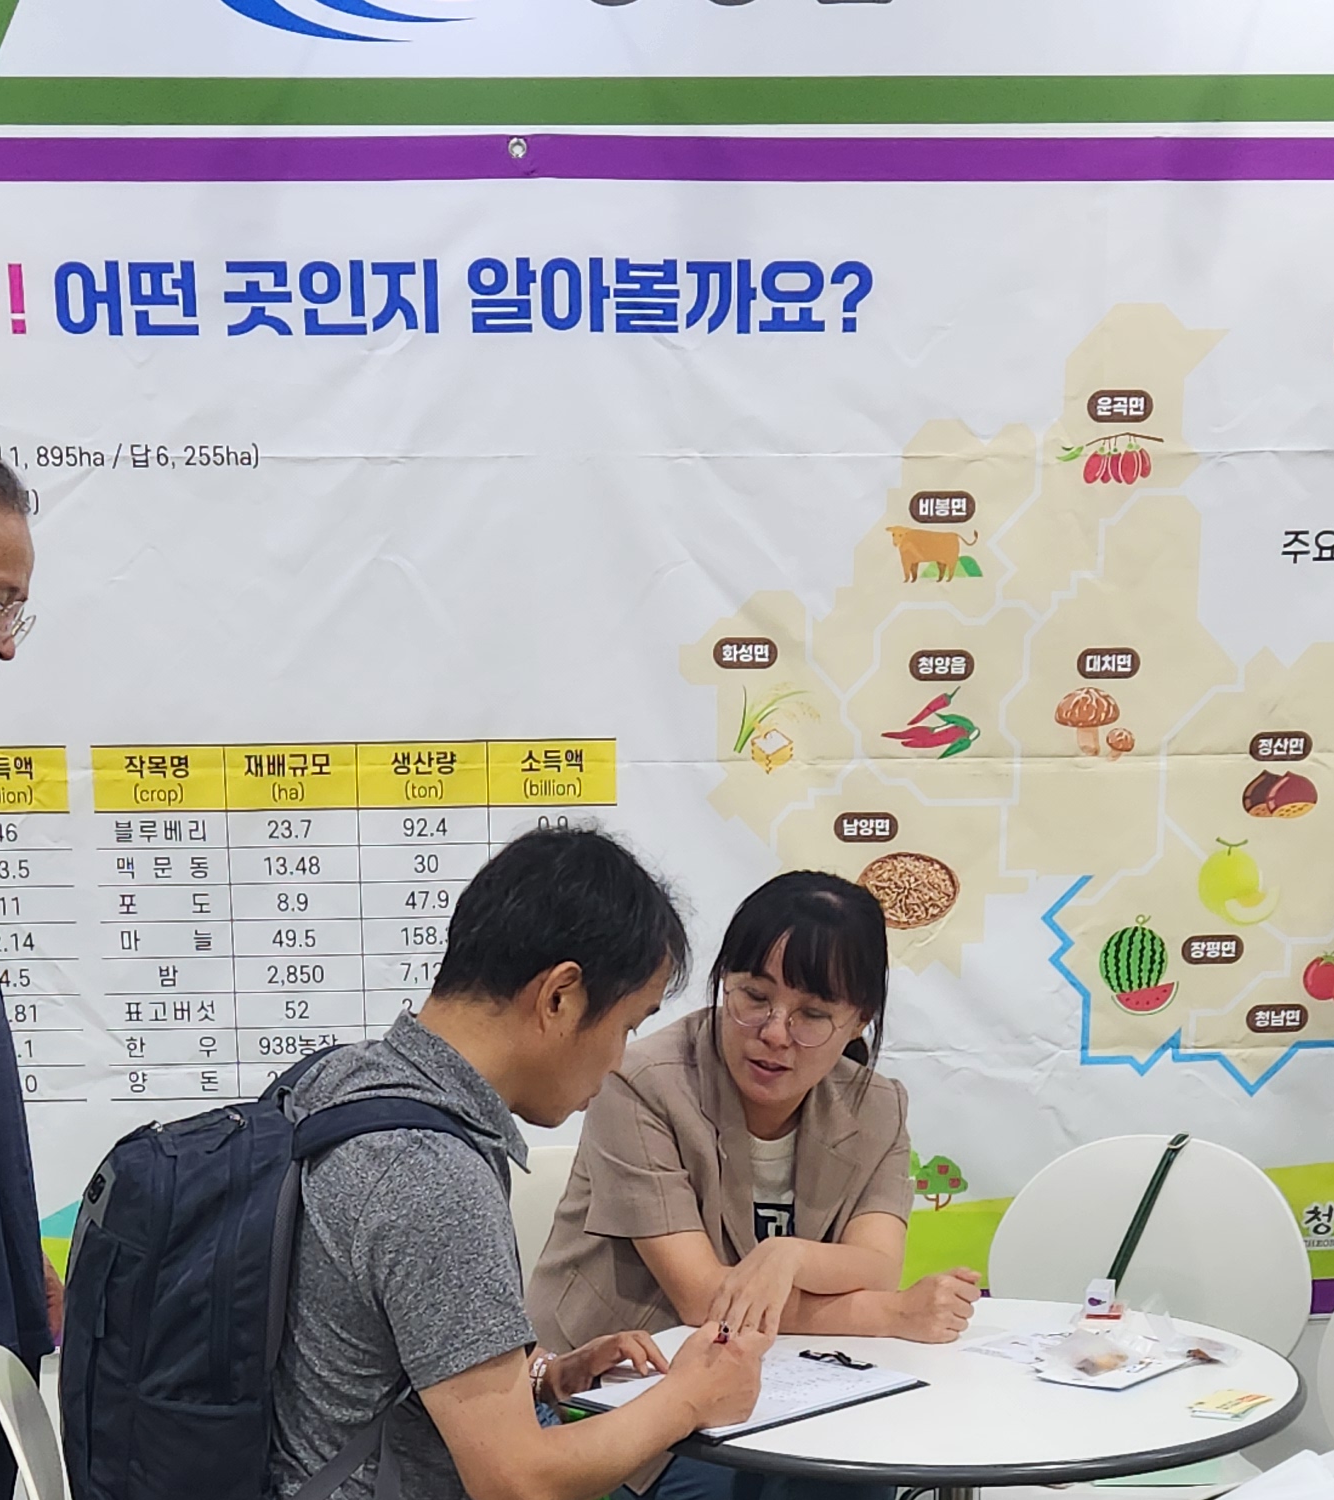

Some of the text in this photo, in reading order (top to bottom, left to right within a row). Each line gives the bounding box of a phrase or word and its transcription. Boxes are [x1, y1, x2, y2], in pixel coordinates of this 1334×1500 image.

[54, 259, 200, 337] 어떤
[223, 258, 440, 337] 곳인지
[468, 256, 874, 335] 알아볼까요?
[1096, 396, 1146, 417] 운곡면
[36, 445, 105, 467] 895ha
[184, 445, 260, 470] 255ha)
[918, 496, 968, 518] 비봉면
[722, 642, 769, 664] 화성면
[1086, 652, 1132, 674] 대치면
[918, 655, 966, 677] 청양읍
[1258, 736, 1305, 757] 정산면
[123, 755, 190, 779] 작목명
[243, 752, 332, 778] 재배규모
[391, 750, 457, 776] 생산량
[521, 748, 584, 774] 소득액
[133, 782, 185, 805] (crop)
[271, 780, 305, 802] (ha)
[404, 779, 445, 800] (ton)
[523, 778, 582, 799] (billion)
[114, 819, 208, 843] 블루베리
[267, 820, 312, 840] 23.7
[402, 817, 448, 838] 92.4
[843, 817, 890, 838] 남양면
[263, 857, 321, 877] 13.48
[414, 854, 439, 875] 30
[276, 893, 309, 913] 8.9
[404, 890, 450, 911] 47.9
[272, 929, 317, 949] 49.5
[1191, 938, 1236, 961] 장평면
[158, 965, 179, 987] 밤
[267, 965, 325, 987] 2,850
[124, 1001, 215, 1024] 표고버섯
[284, 1000, 309, 1020] 52
[1254, 1006, 1300, 1029] 청남면
